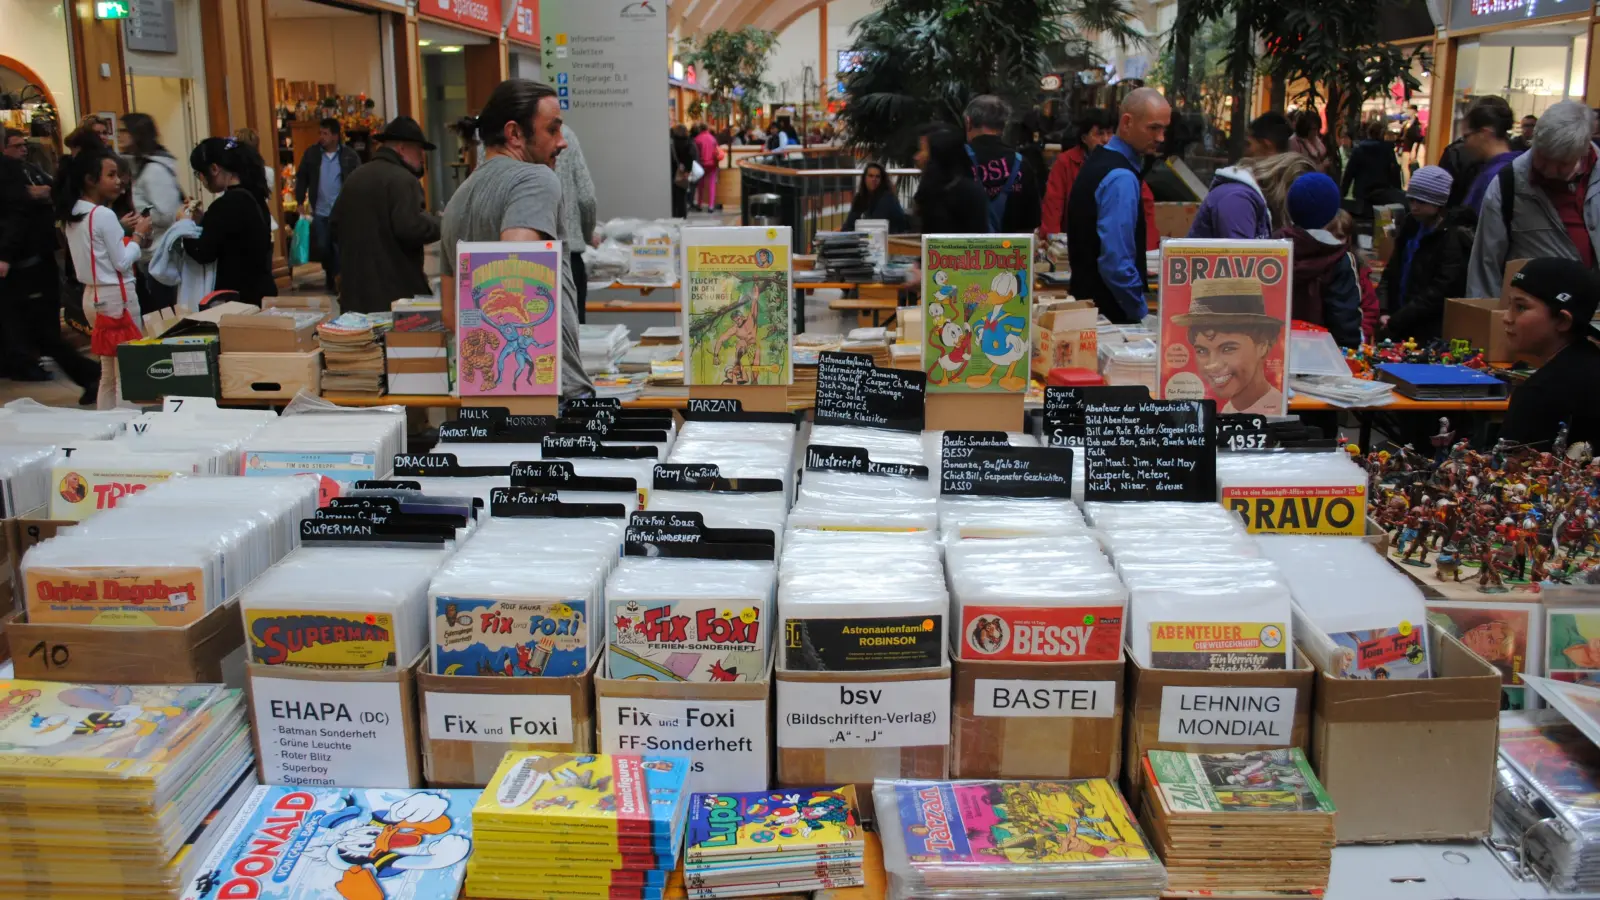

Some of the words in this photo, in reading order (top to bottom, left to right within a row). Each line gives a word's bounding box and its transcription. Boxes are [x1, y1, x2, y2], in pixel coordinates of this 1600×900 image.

[572, 62, 614, 70] Verwaltung
[699, 252, 757, 264] Tarzan
[928, 250, 981, 270] Donald
[984, 249, 1027, 270] Duck
[1168, 257, 1283, 286] BRAVO
[150, 367, 173, 375] Biotrend
[818, 390, 842, 399] Doktor
[1047, 388, 1074, 401] Sigurd
[170, 400, 183, 412] 7
[690, 401, 737, 412] TARZAN
[1086, 404, 1120, 412] Abenteuer
[1139, 403, 1190, 415] Weltgeschichte
[460, 409, 489, 419] HULK
[854, 412, 887, 423] Klassiker
[1085, 416, 1102, 424] Bild
[1103, 415, 1140, 424] Abenteuer
[506, 417, 547, 427] HORROR
[471, 427, 487, 437] VIER
[1085, 427, 1101, 436] Bill
[1103, 427, 1113, 435] der
[1116, 427, 1131, 435] Rote
[943, 436, 966, 446] Bastei
[968, 436, 1008, 446] Sonderband
[1102, 438, 1117, 446] und
[1187, 437, 1204, 445] Welt
[1227, 434, 1267, 451] 1957
[943, 448, 974, 457] BESSY
[1088, 448, 1105, 456] Falk
[395, 456, 449, 467] DRACULA
[808, 450, 862, 468] Illustrierte
[868, 462, 914, 476] Klassiker
[943, 460, 981, 470] Bonanza,
[983, 460, 1012, 471] Buffalo
[1087, 457, 1102, 469] Jan
[1177, 459, 1195, 471] May
[655, 466, 680, 481] Perry
[943, 471, 964, 479] Chick
[966, 472, 982, 481] Bill,
[984, 472, 1022, 483] Gespenster
[1024, 472, 1066, 484] Geschichten,
[1137, 469, 1170, 479] Meteor,
[944, 481, 972, 490] LASSO
[1089, 481, 1115, 492] Nick,
[493, 491, 508, 503] Fix
[518, 493, 537, 503] Foxi
[1231, 497, 1354, 528] BRAVO
[302, 522, 372, 534] SUPERMAN
[480, 610, 514, 633] Fix
[529, 614, 580, 636] Foxi
[644, 605, 691, 643] Fix
[1157, 626, 1241, 639] ABENTEUER
[264, 626, 389, 665] SUPERMAN
[859, 636, 916, 646] ROBINSON
[1012, 625, 1094, 655] BESSY
[648, 643, 755, 651] FERIEN-SONDERHEFT
[28, 641, 69, 670] 10
[1210, 654, 1227, 663] Ein
[1228, 653, 1268, 664] Verräter
[840, 686, 882, 705] bsv
[993, 688, 1096, 710] BASTEI
[1180, 694, 1280, 712] LEHNING
[270, 700, 352, 722] EHAPA
[360, 712, 389, 725] (DC)
[618, 707, 652, 725] Fix
[659, 719, 678, 727] und
[687, 708, 734, 727] Foxi
[787, 711, 936, 726] (Bildschriften-Verlag)
[444, 715, 478, 734] Fix
[484, 727, 503, 735] und
[510, 717, 557, 735] Foxi
[1178, 719, 1279, 736] MONDIAL
[279, 726, 317, 736] Batman
[320, 729, 376, 738] Sonderheft
[280, 738, 308, 748] Grüne
[312, 741, 351, 750] Leuchte
[619, 736, 752, 752] FF-Sonderheft
[281, 751, 307, 760] Roter
[310, 752, 331, 761] Blitz
[283, 764, 328, 774] Superboy
[284, 776, 335, 786] Superman
[618, 759, 634, 813] Comicfiguren
[700, 796, 745, 847] Lupo
[919, 786, 955, 852] Tarzan
[217, 791, 315, 900] DONALD
[277, 862, 293, 877] VON
